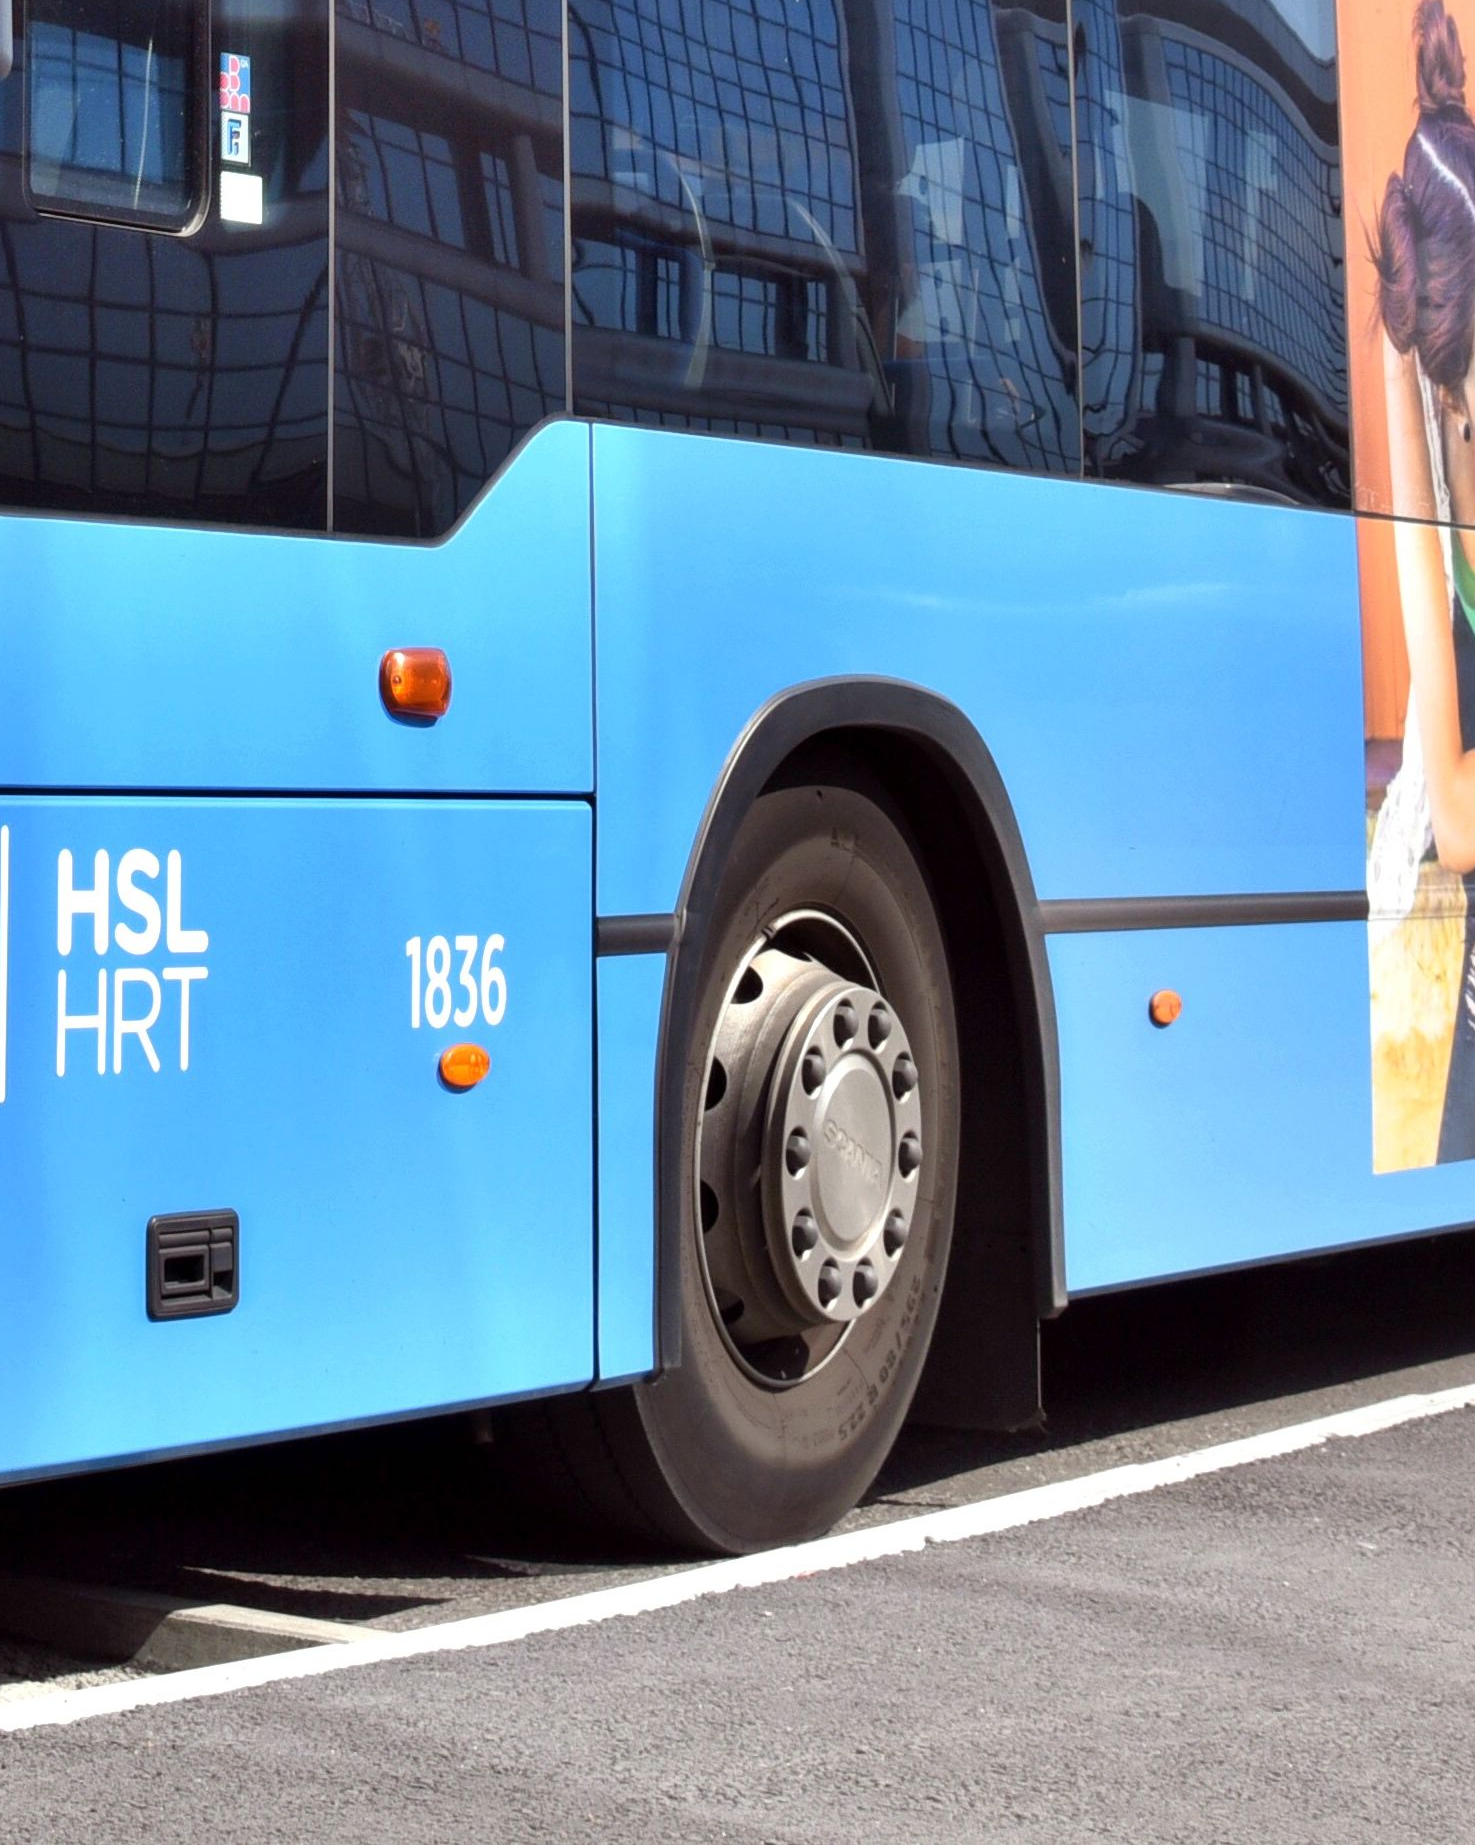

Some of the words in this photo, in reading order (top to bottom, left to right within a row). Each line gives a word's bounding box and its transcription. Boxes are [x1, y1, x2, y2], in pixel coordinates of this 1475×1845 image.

[56, 846, 210, 957] HSL
[56, 964, 209, 1077] HRT
[404, 932, 508, 1029] 1836
[822, 1116, 884, 1191] SCANIA
